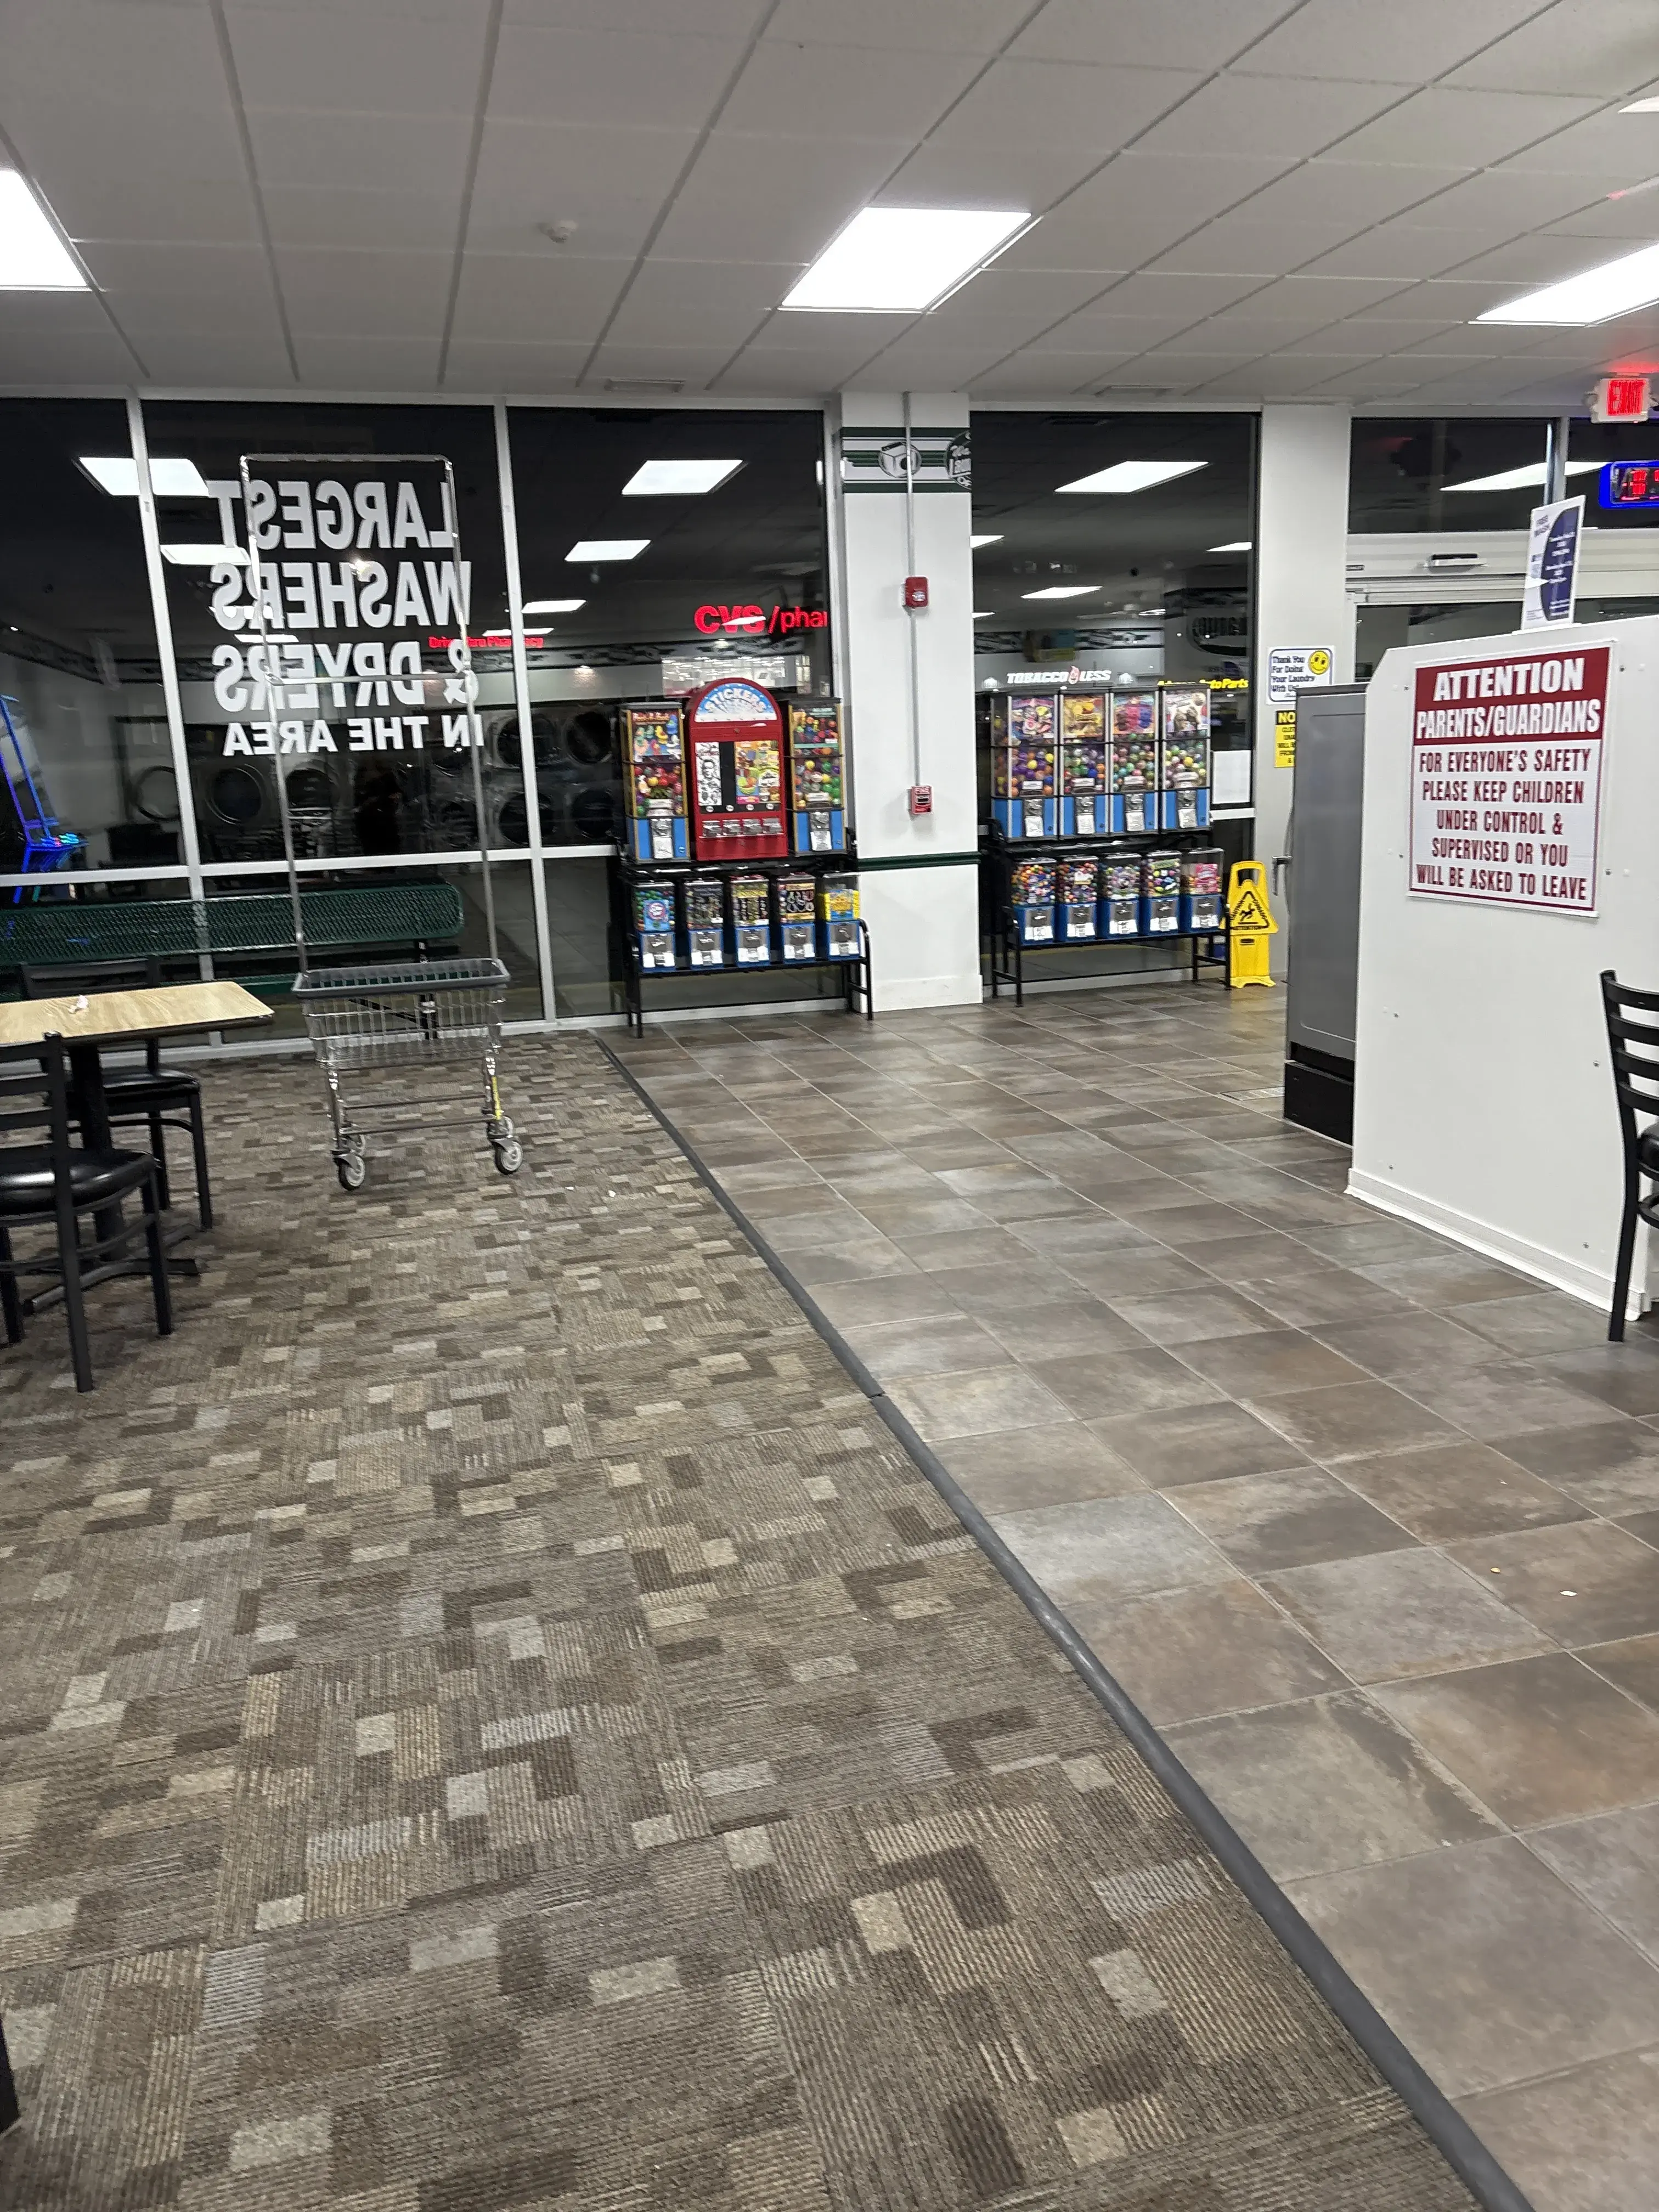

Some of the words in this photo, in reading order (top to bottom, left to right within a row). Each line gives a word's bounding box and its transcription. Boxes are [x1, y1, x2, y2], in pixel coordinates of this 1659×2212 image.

[1607, 380, 1646, 416] EXIT
[1007, 672, 1069, 684] TOBACCO
[1079, 670, 1112, 681] LESS
[1222, 678, 1249, 689] Parts
[1432, 658, 1585, 702] ATTENTION
[704, 687, 766, 713] STICKERS
[1415, 698, 1601, 739] PARENTS/GUARDIANS
[1419, 752, 1442, 772] FOR
[1447, 749, 1528, 772] EVERYONE'S
[1534, 748, 1592, 771] SAFETY
[1422, 781, 1468, 801] PLEASE
[1473, 781, 1507, 802] KEEP
[1513, 781, 1584, 803] CHILDREN
[1437, 810, 1478, 831] UNDER
[1483, 811, 1546, 834] CONTROL
[1551, 812, 1564, 835] &
[1431, 837, 1510, 862] SUPERVISED
[1515, 842, 1534, 864] OR
[1541, 843, 1569, 867] YOU
[1416, 864, 1444, 885] WILL
[1448, 867, 1465, 887] BE
[1469, 869, 1513, 892] ASKED
[1518, 873, 1536, 895] TO
[1541, 874, 1588, 900] LEAVE
